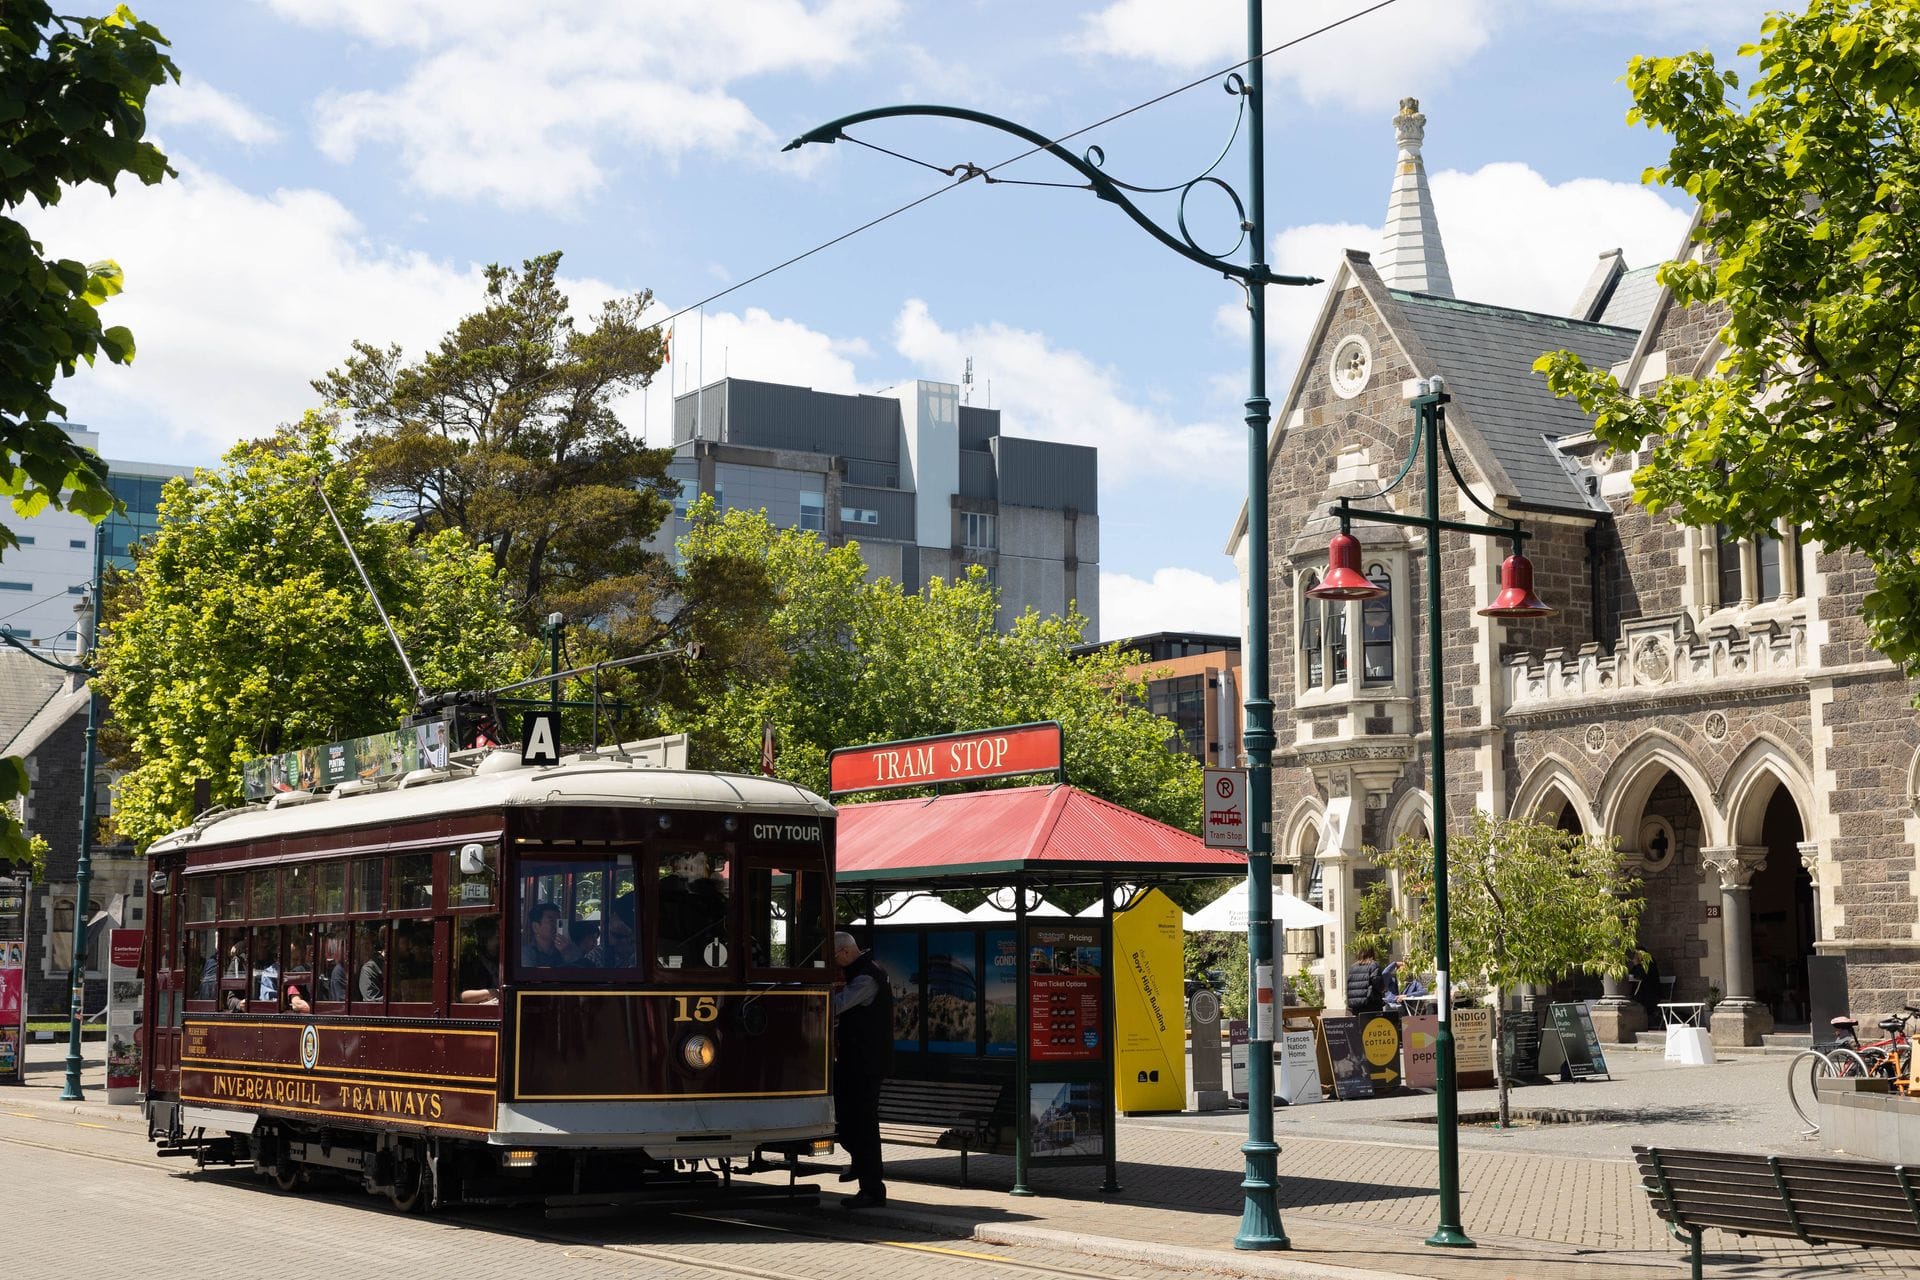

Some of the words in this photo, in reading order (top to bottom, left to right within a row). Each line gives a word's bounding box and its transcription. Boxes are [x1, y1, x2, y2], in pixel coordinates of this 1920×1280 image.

[525, 716, 557, 760] A
[872, 746, 935, 781] TRAM
[950, 737, 1009, 773] STOP
[753, 824, 783, 840] CITY
[784, 825, 820, 841] TOUR
[1209, 831, 1226, 840] Tram
[1226, 831, 1243, 841] Stop
[1707, 907, 1718, 916] 28
[1068, 934, 1093, 943] Pricing
[1033, 980, 1048, 988] Tram
[1049, 980, 1066, 988] Ticket
[1065, 980, 1088, 989] Options
[1132, 952, 1146, 974] Boys'
[1141, 975, 1153, 997] High
[1149, 996, 1166, 1032] Building
[673, 996, 719, 1022] 15
[1555, 1007, 1568, 1018] Art
[1454, 1012, 1487, 1021] INDIGO
[1368, 1030, 1392, 1038] FUDGE
[1286, 1035, 1310, 1043] Frances
[1364, 1038, 1396, 1047] COTTAGE
[1287, 1042, 1307, 1050] Nation
[1288, 1050, 1306, 1058] Home
[213, 1075, 321, 1106] INVERCARGILL
[339, 1086, 442, 1118] TRAMWAYS
